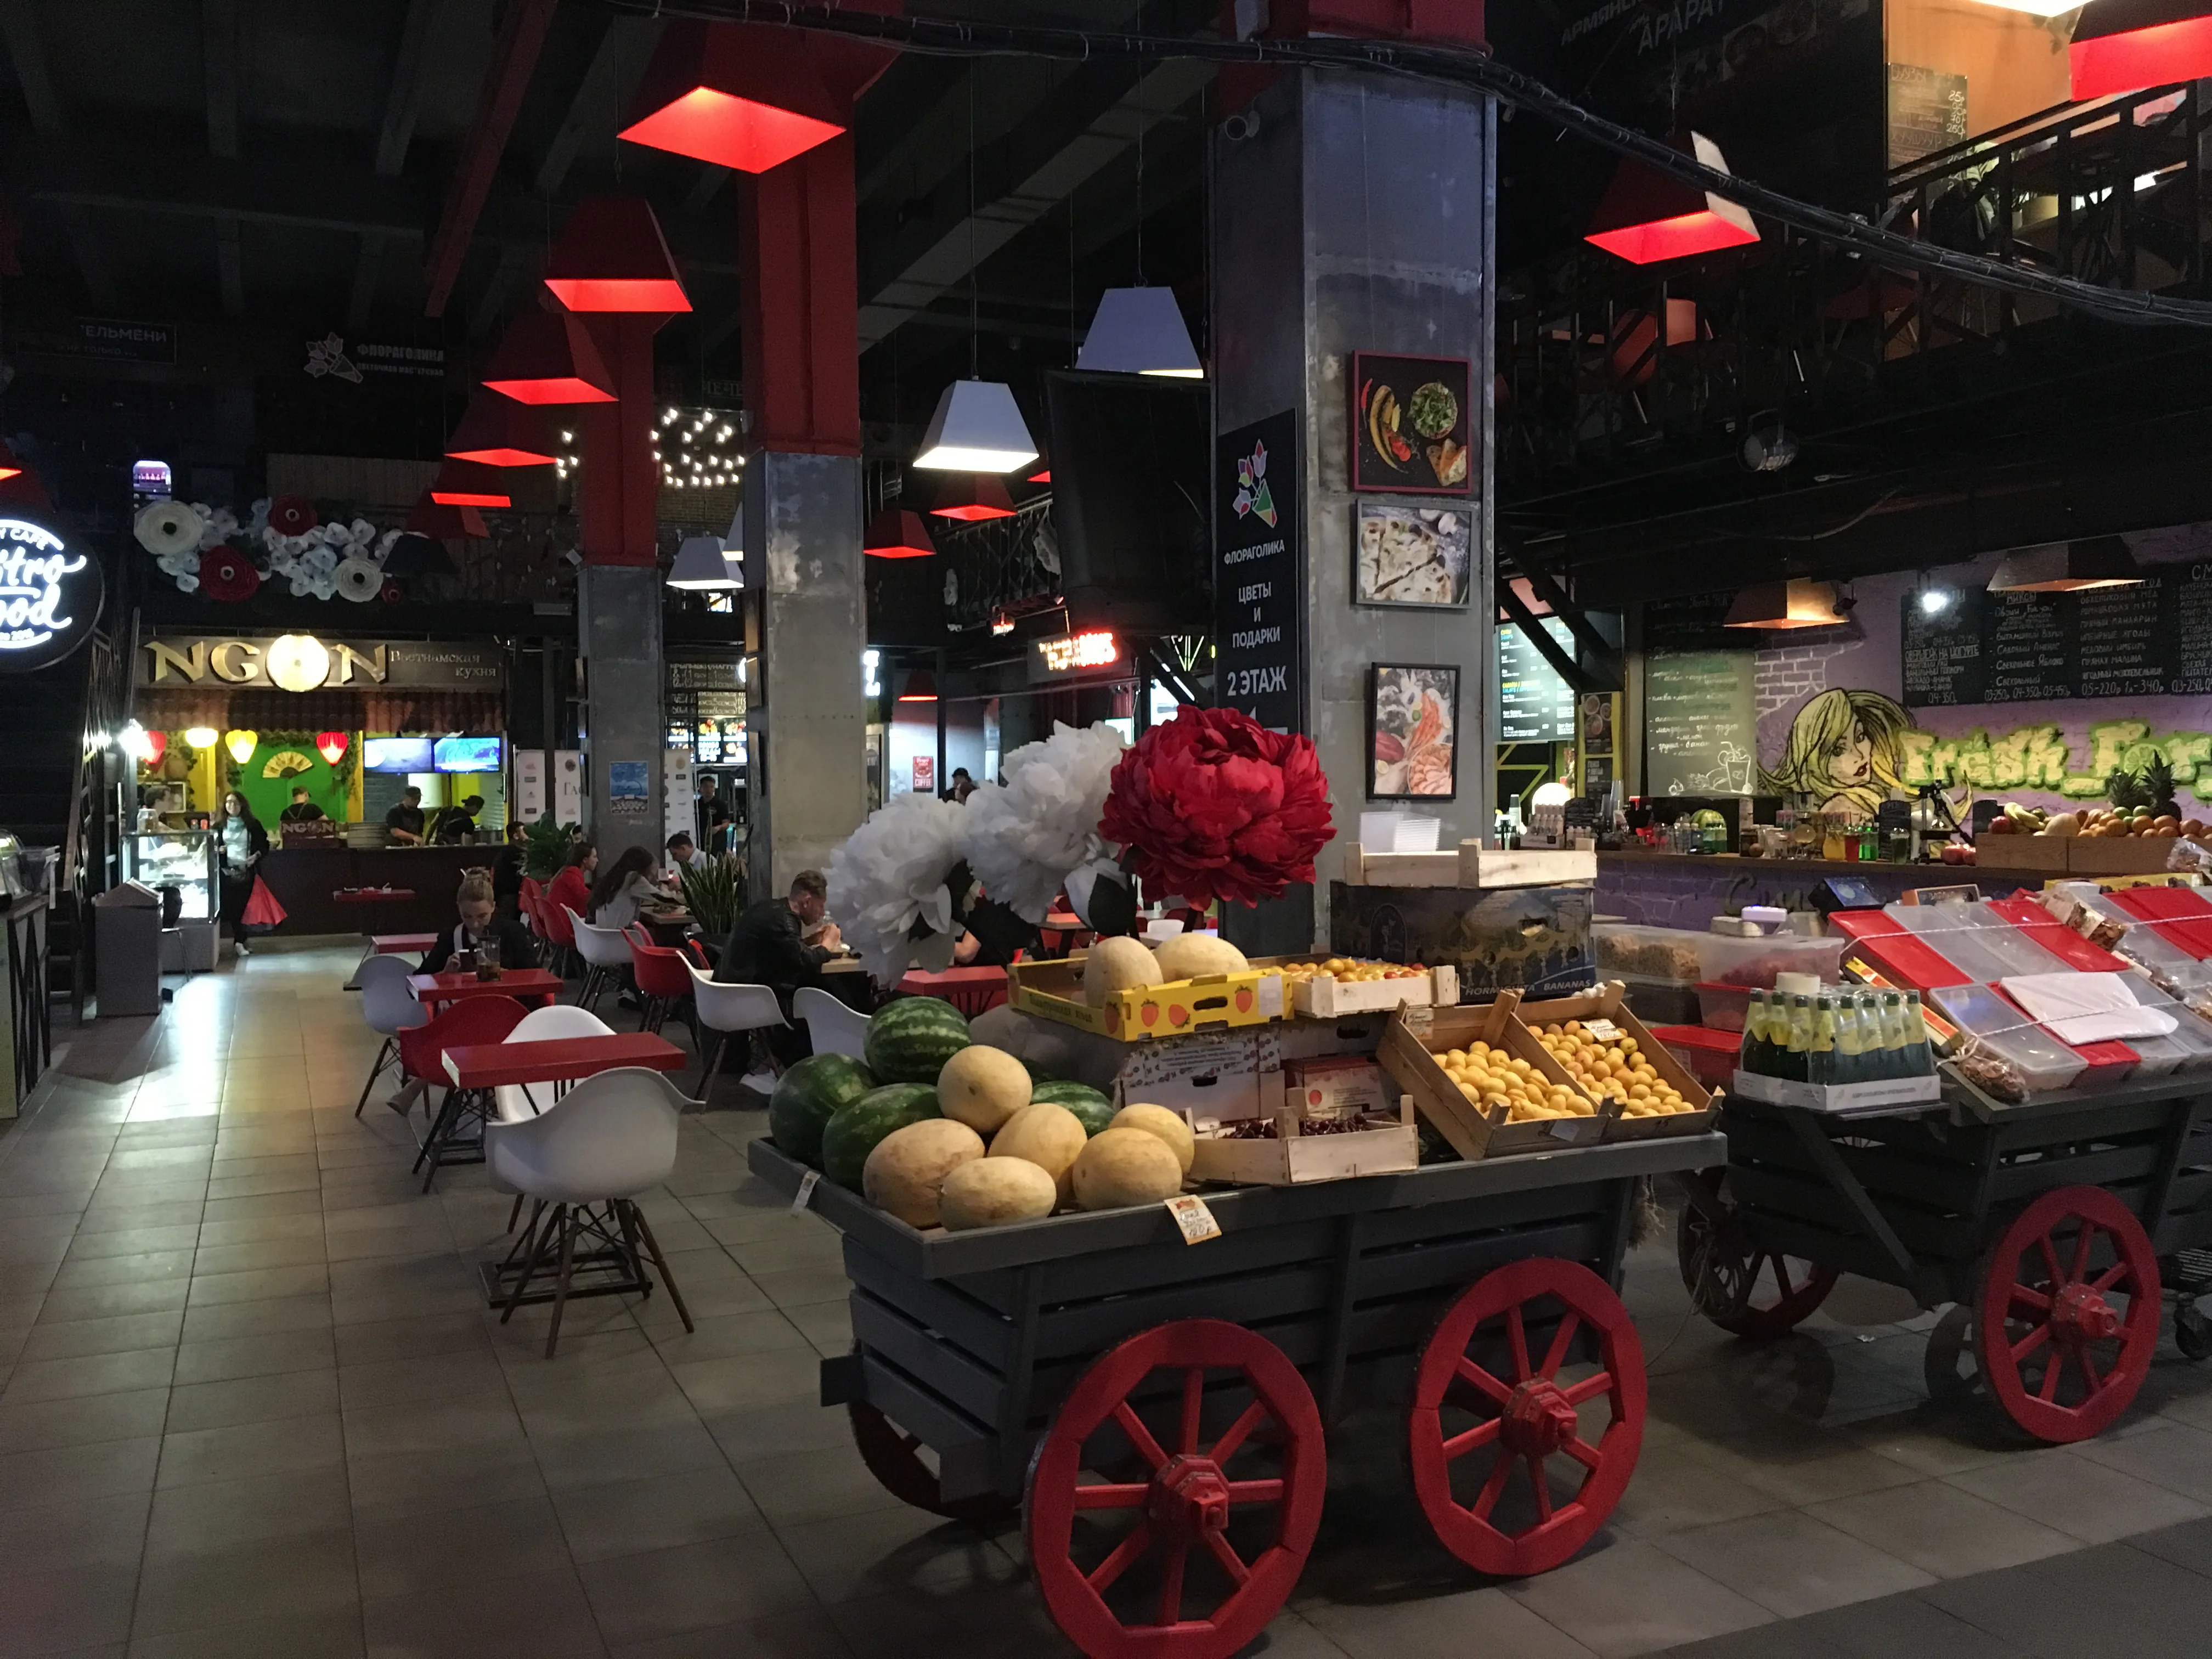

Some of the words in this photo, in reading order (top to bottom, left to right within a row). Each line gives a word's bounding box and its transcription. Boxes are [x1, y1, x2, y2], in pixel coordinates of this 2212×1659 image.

[80, 324, 167, 342] ЕЛЬМЕНИ
[1223, 539, 1285, 566] ФЛОРАГОЛИКА
[1238, 582, 1272, 605] ЦВЕТЫ
[1253, 606, 1261, 623] И
[1232, 626, 1281, 649] ПОДАРКИ
[390, 650, 481, 663] Вьетнамская
[455, 667, 496, 679] кухня
[1227, 672, 1237, 696] 2
[1240, 665, 1288, 696] ЭТАЖ
[1543, 979, 1591, 991] BANANAS
